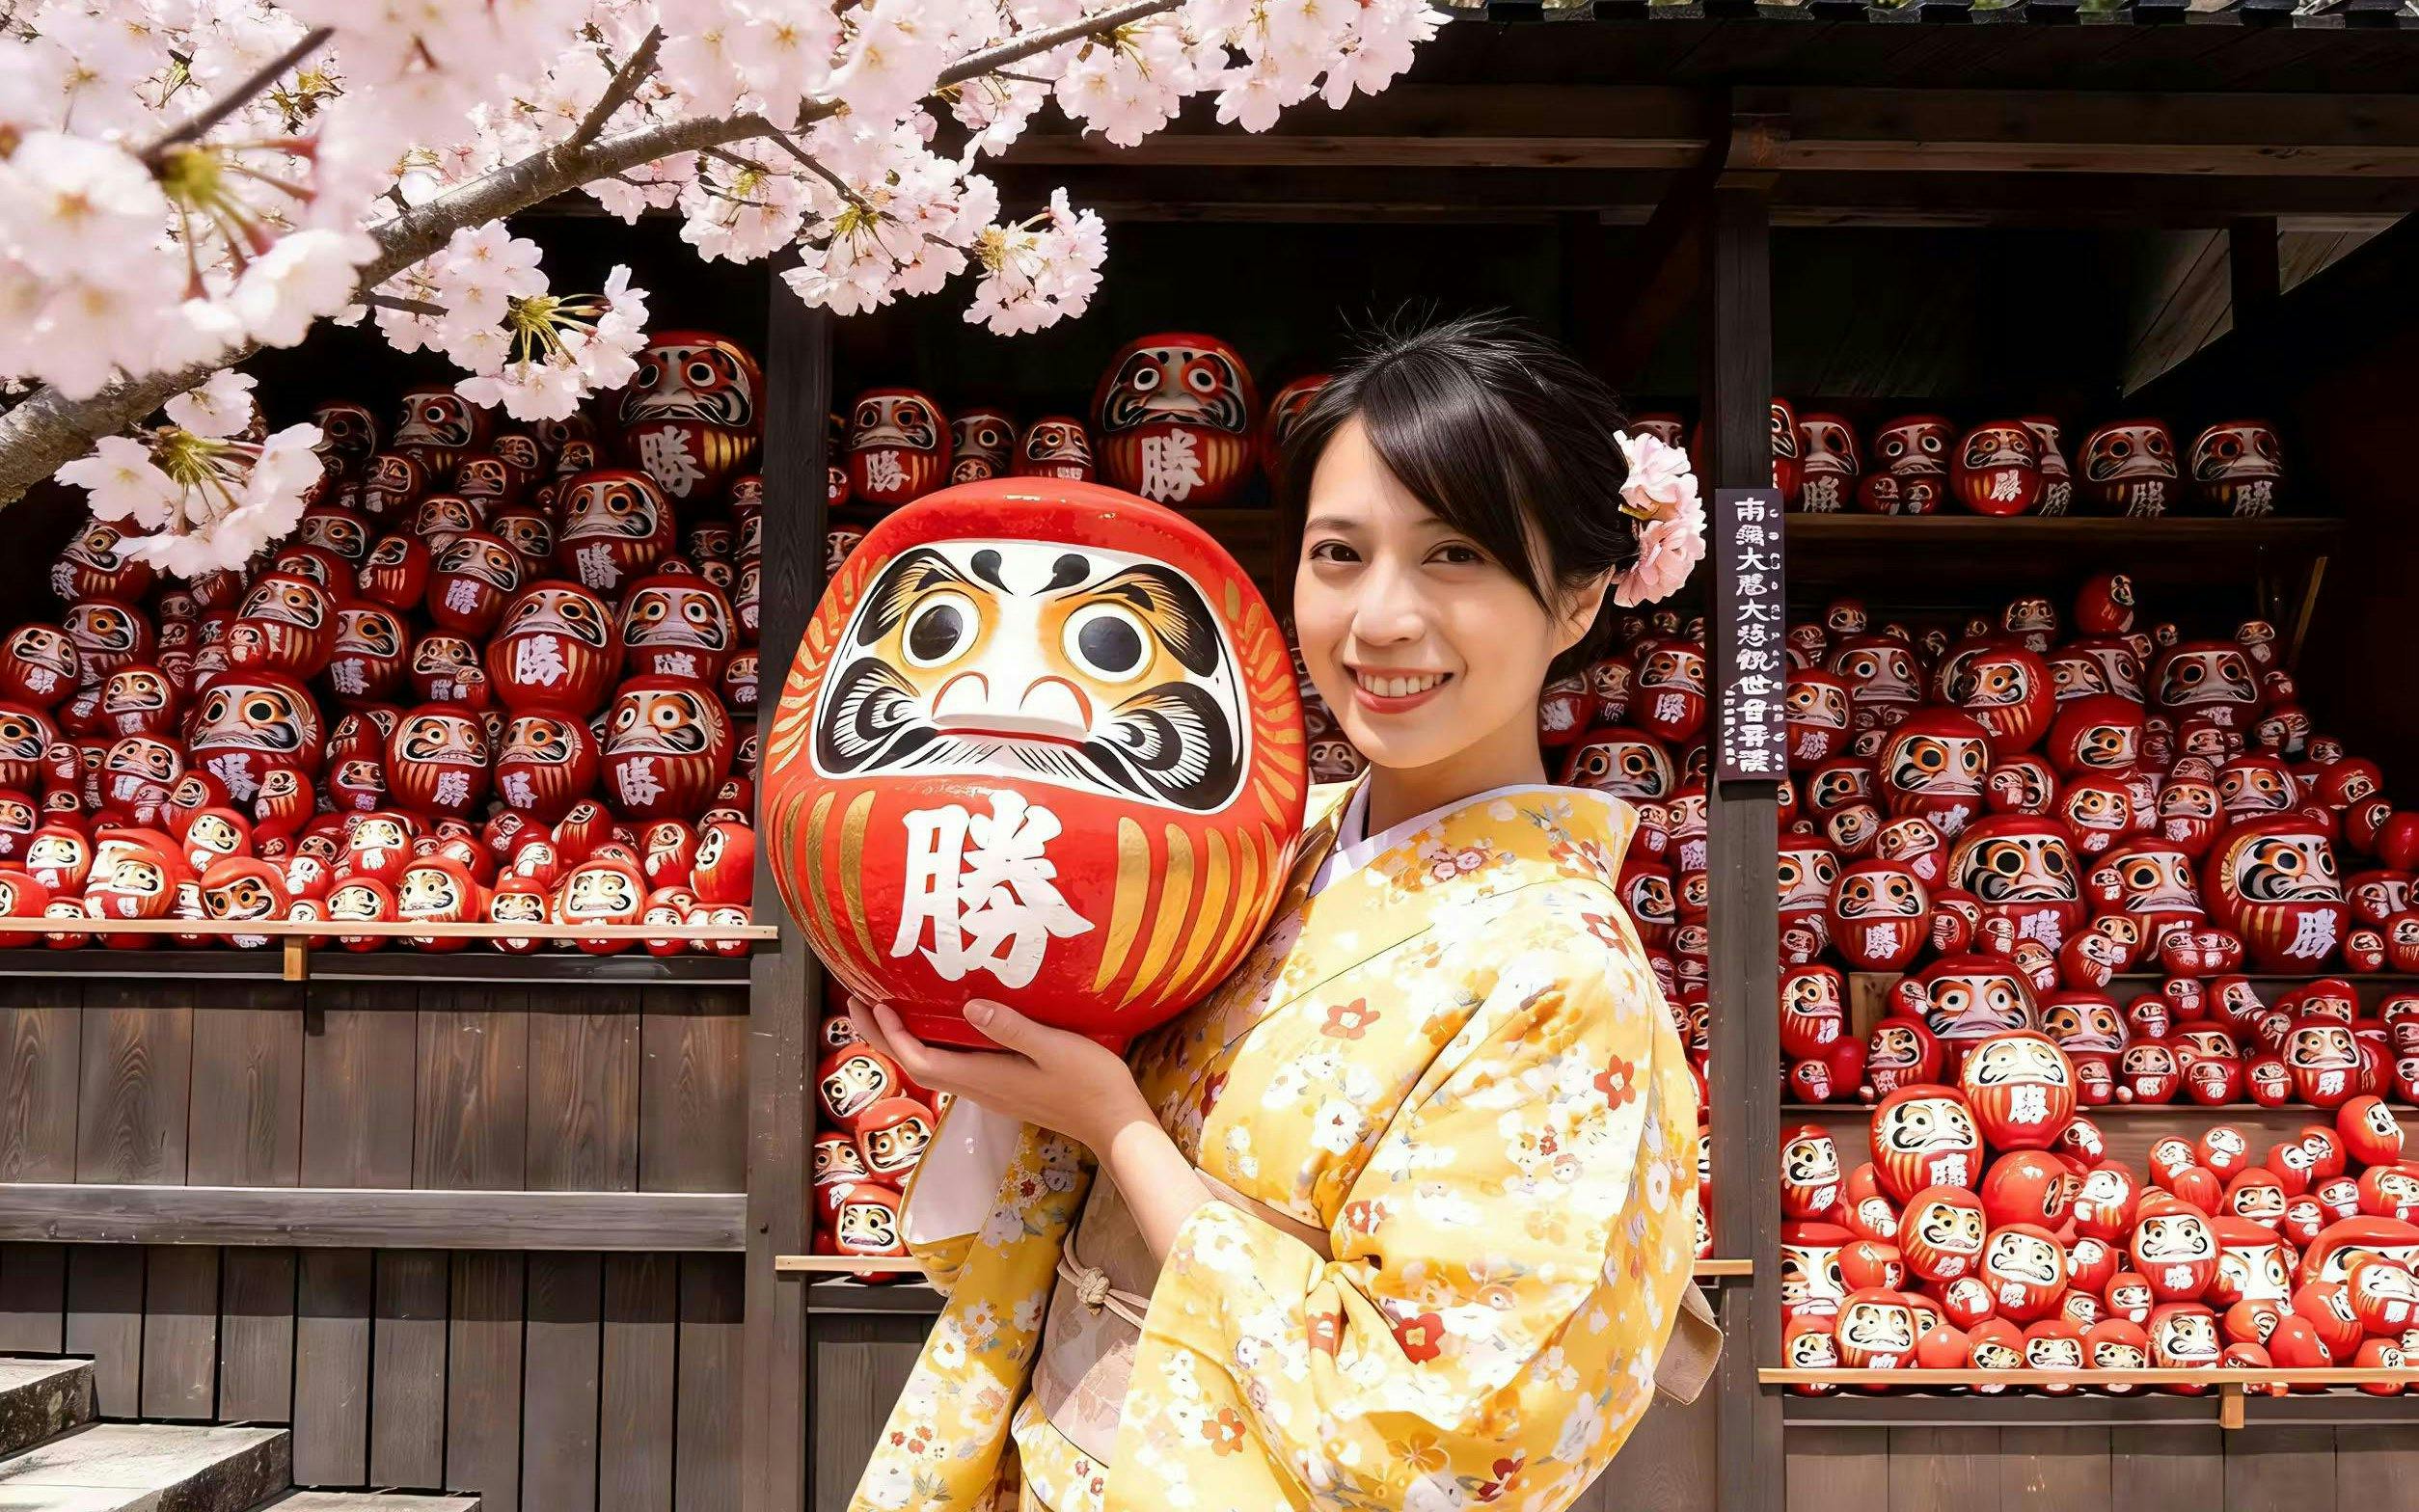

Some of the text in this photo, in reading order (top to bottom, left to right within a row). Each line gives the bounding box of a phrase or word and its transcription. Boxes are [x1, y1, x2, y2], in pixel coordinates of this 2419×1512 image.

[866, 450, 911, 492] 勝
[1141, 427, 1205, 502] 勝
[889, 789, 1096, 989] 勝
